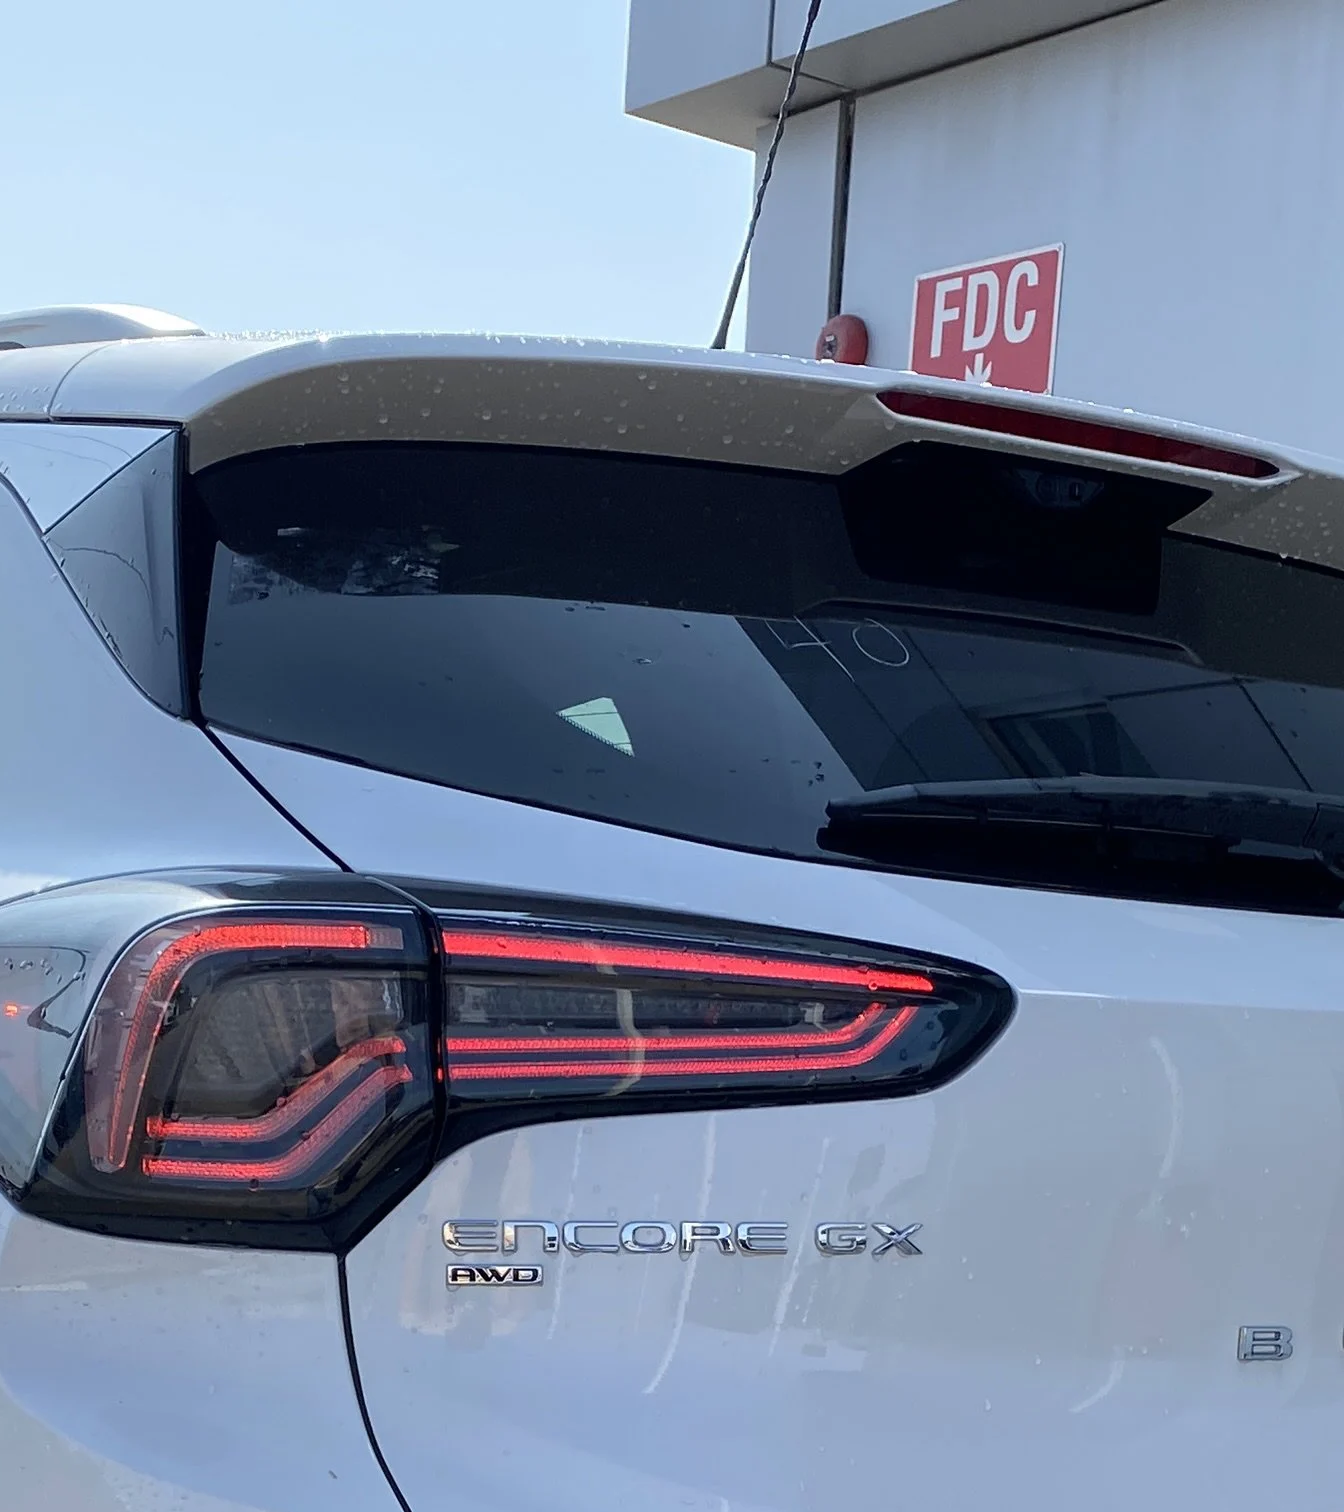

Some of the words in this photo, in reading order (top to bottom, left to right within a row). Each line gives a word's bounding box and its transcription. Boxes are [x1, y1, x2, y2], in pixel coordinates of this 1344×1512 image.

[930, 260, 1039, 359] FDC
[442, 1219, 788, 1254] ENCORE
[813, 1221, 924, 1256] GX
[448, 1265, 542, 1285] AWD
